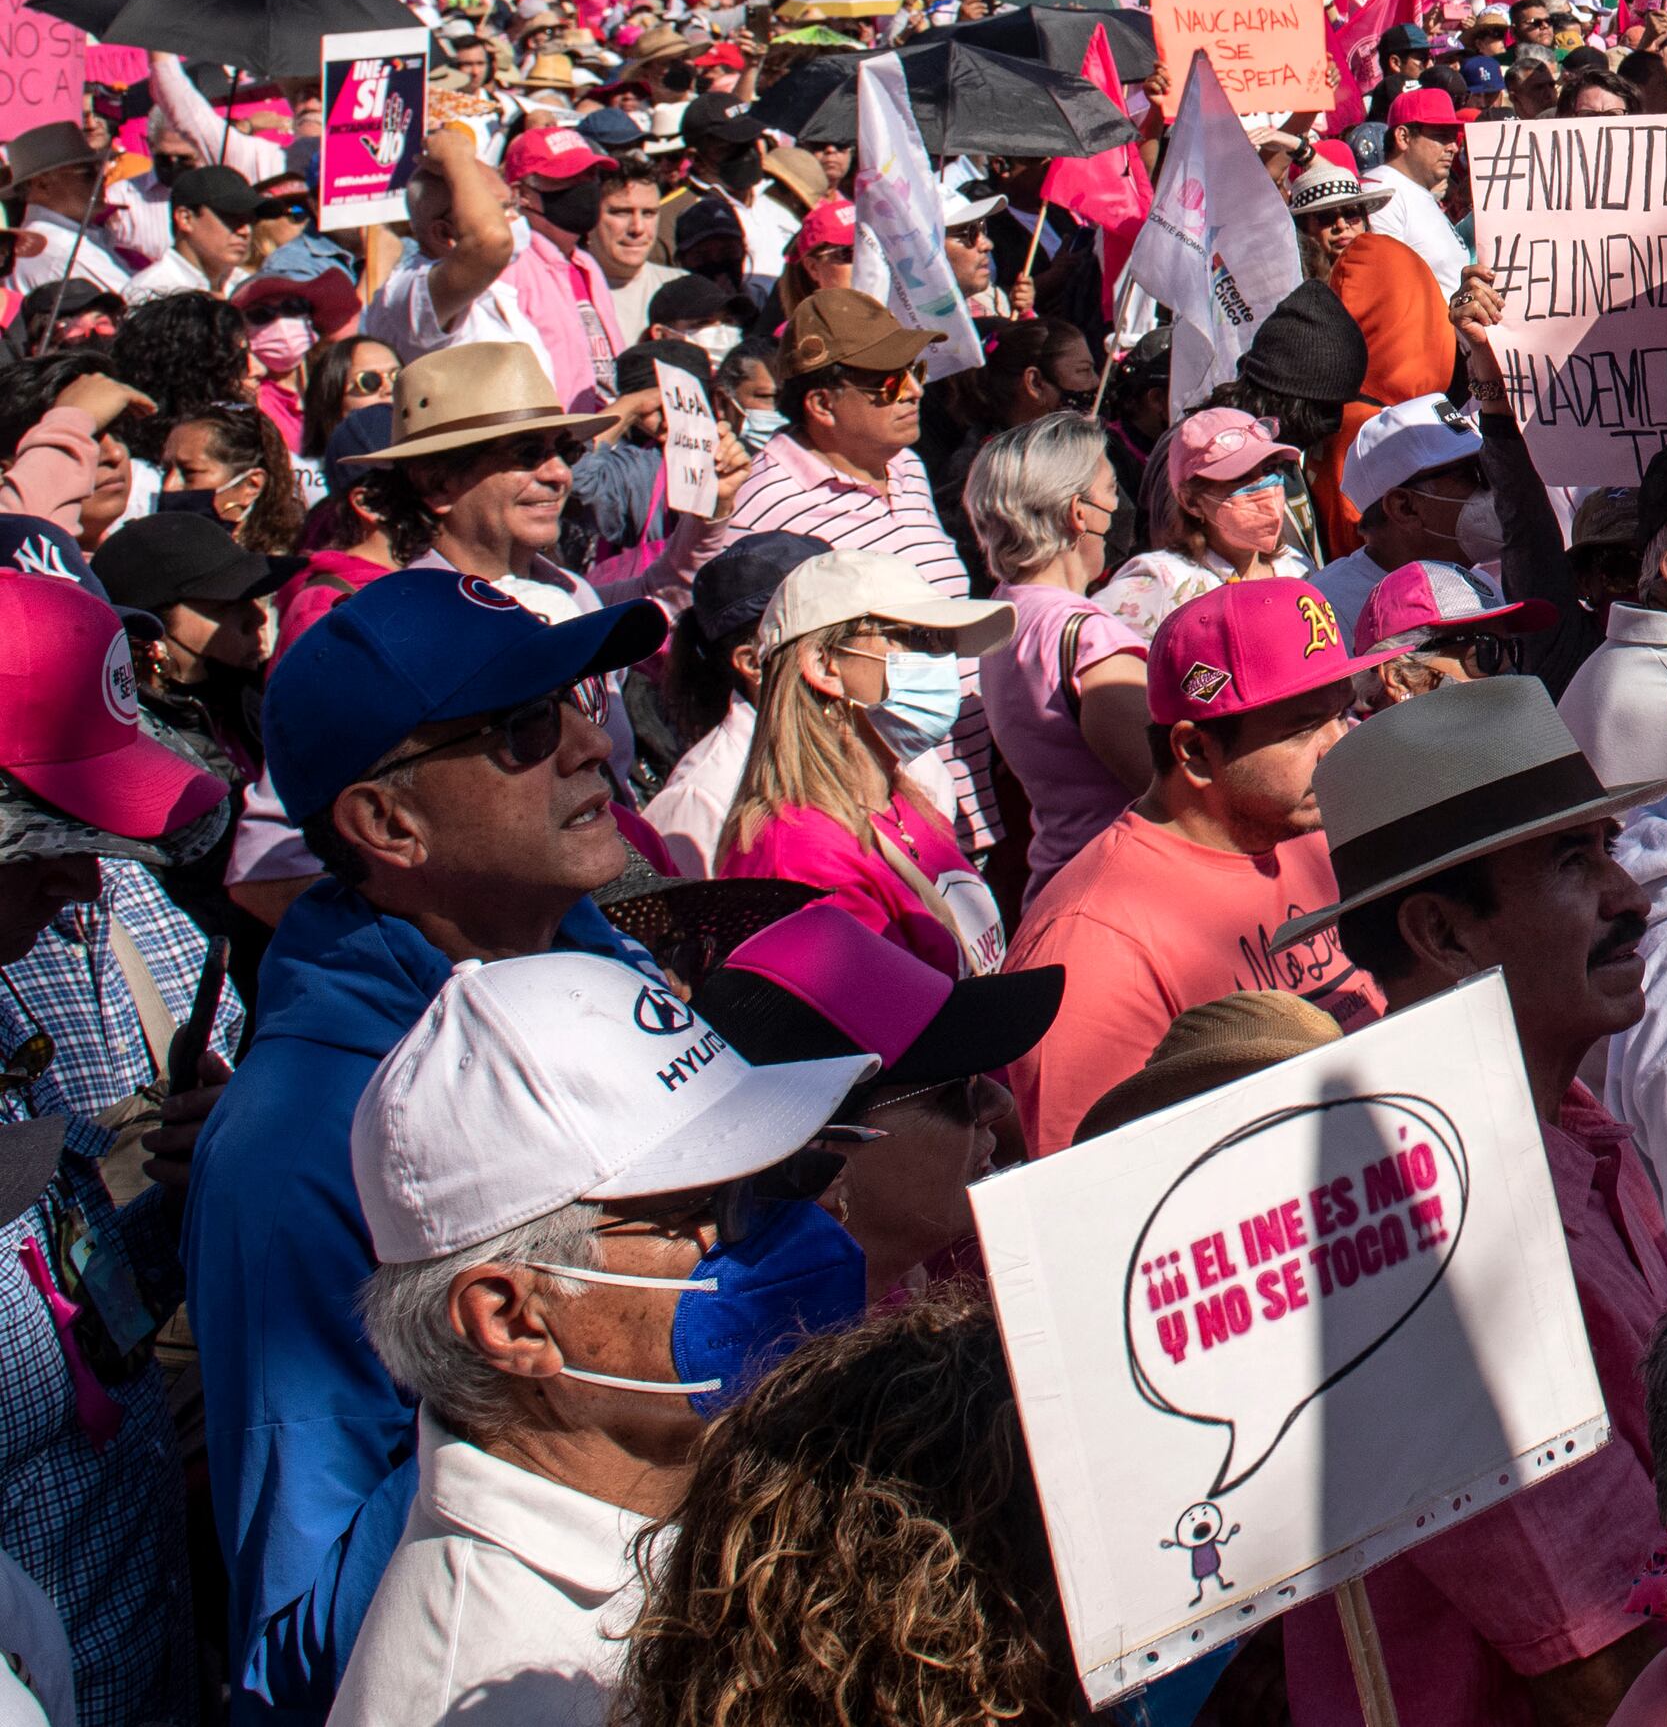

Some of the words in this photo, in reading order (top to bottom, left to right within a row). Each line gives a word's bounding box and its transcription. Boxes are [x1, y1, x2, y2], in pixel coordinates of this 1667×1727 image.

[1173, 3, 1300, 34] NAUCALPAN
[1215, 39, 1254, 61] SE
[1221, 275, 1255, 324] Frente
[1189, 1232, 1238, 1291] EL
[1239, 1197, 1309, 1269] INE
[1307, 1175, 1360, 1239] ES
[1361, 1125, 1439, 1216] MÍO
[1156, 1309, 1190, 1366] Y
[1193, 1283, 1253, 1352] NO
[1255, 1257, 1310, 1322] SE
[1308, 1213, 1410, 1299] TOCA
